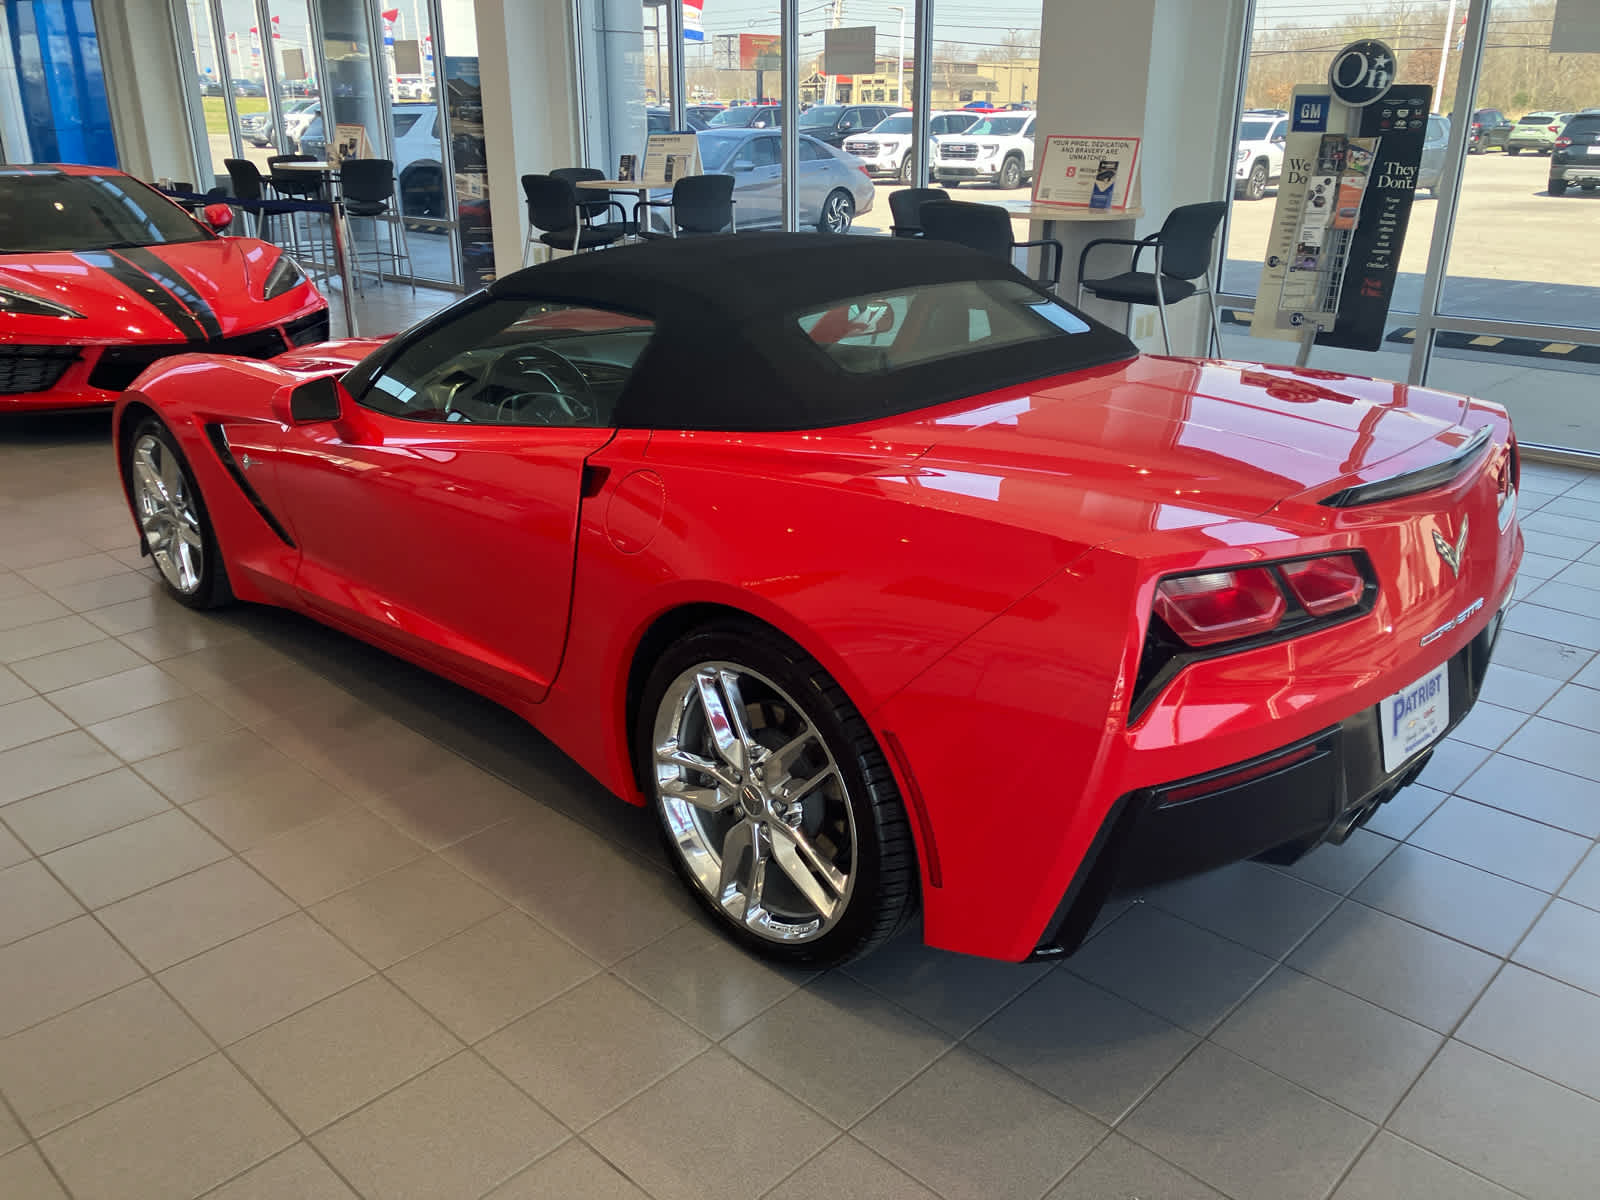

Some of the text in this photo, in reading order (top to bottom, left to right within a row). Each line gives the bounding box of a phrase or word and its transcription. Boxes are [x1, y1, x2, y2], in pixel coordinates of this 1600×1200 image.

[1333, 52, 1388, 88] On
[1301, 103, 1321, 119] GM
[1289, 158, 1312, 172] We
[1384, 161, 1417, 177] They
[1393, 673, 1442, 737] PATRIOT
